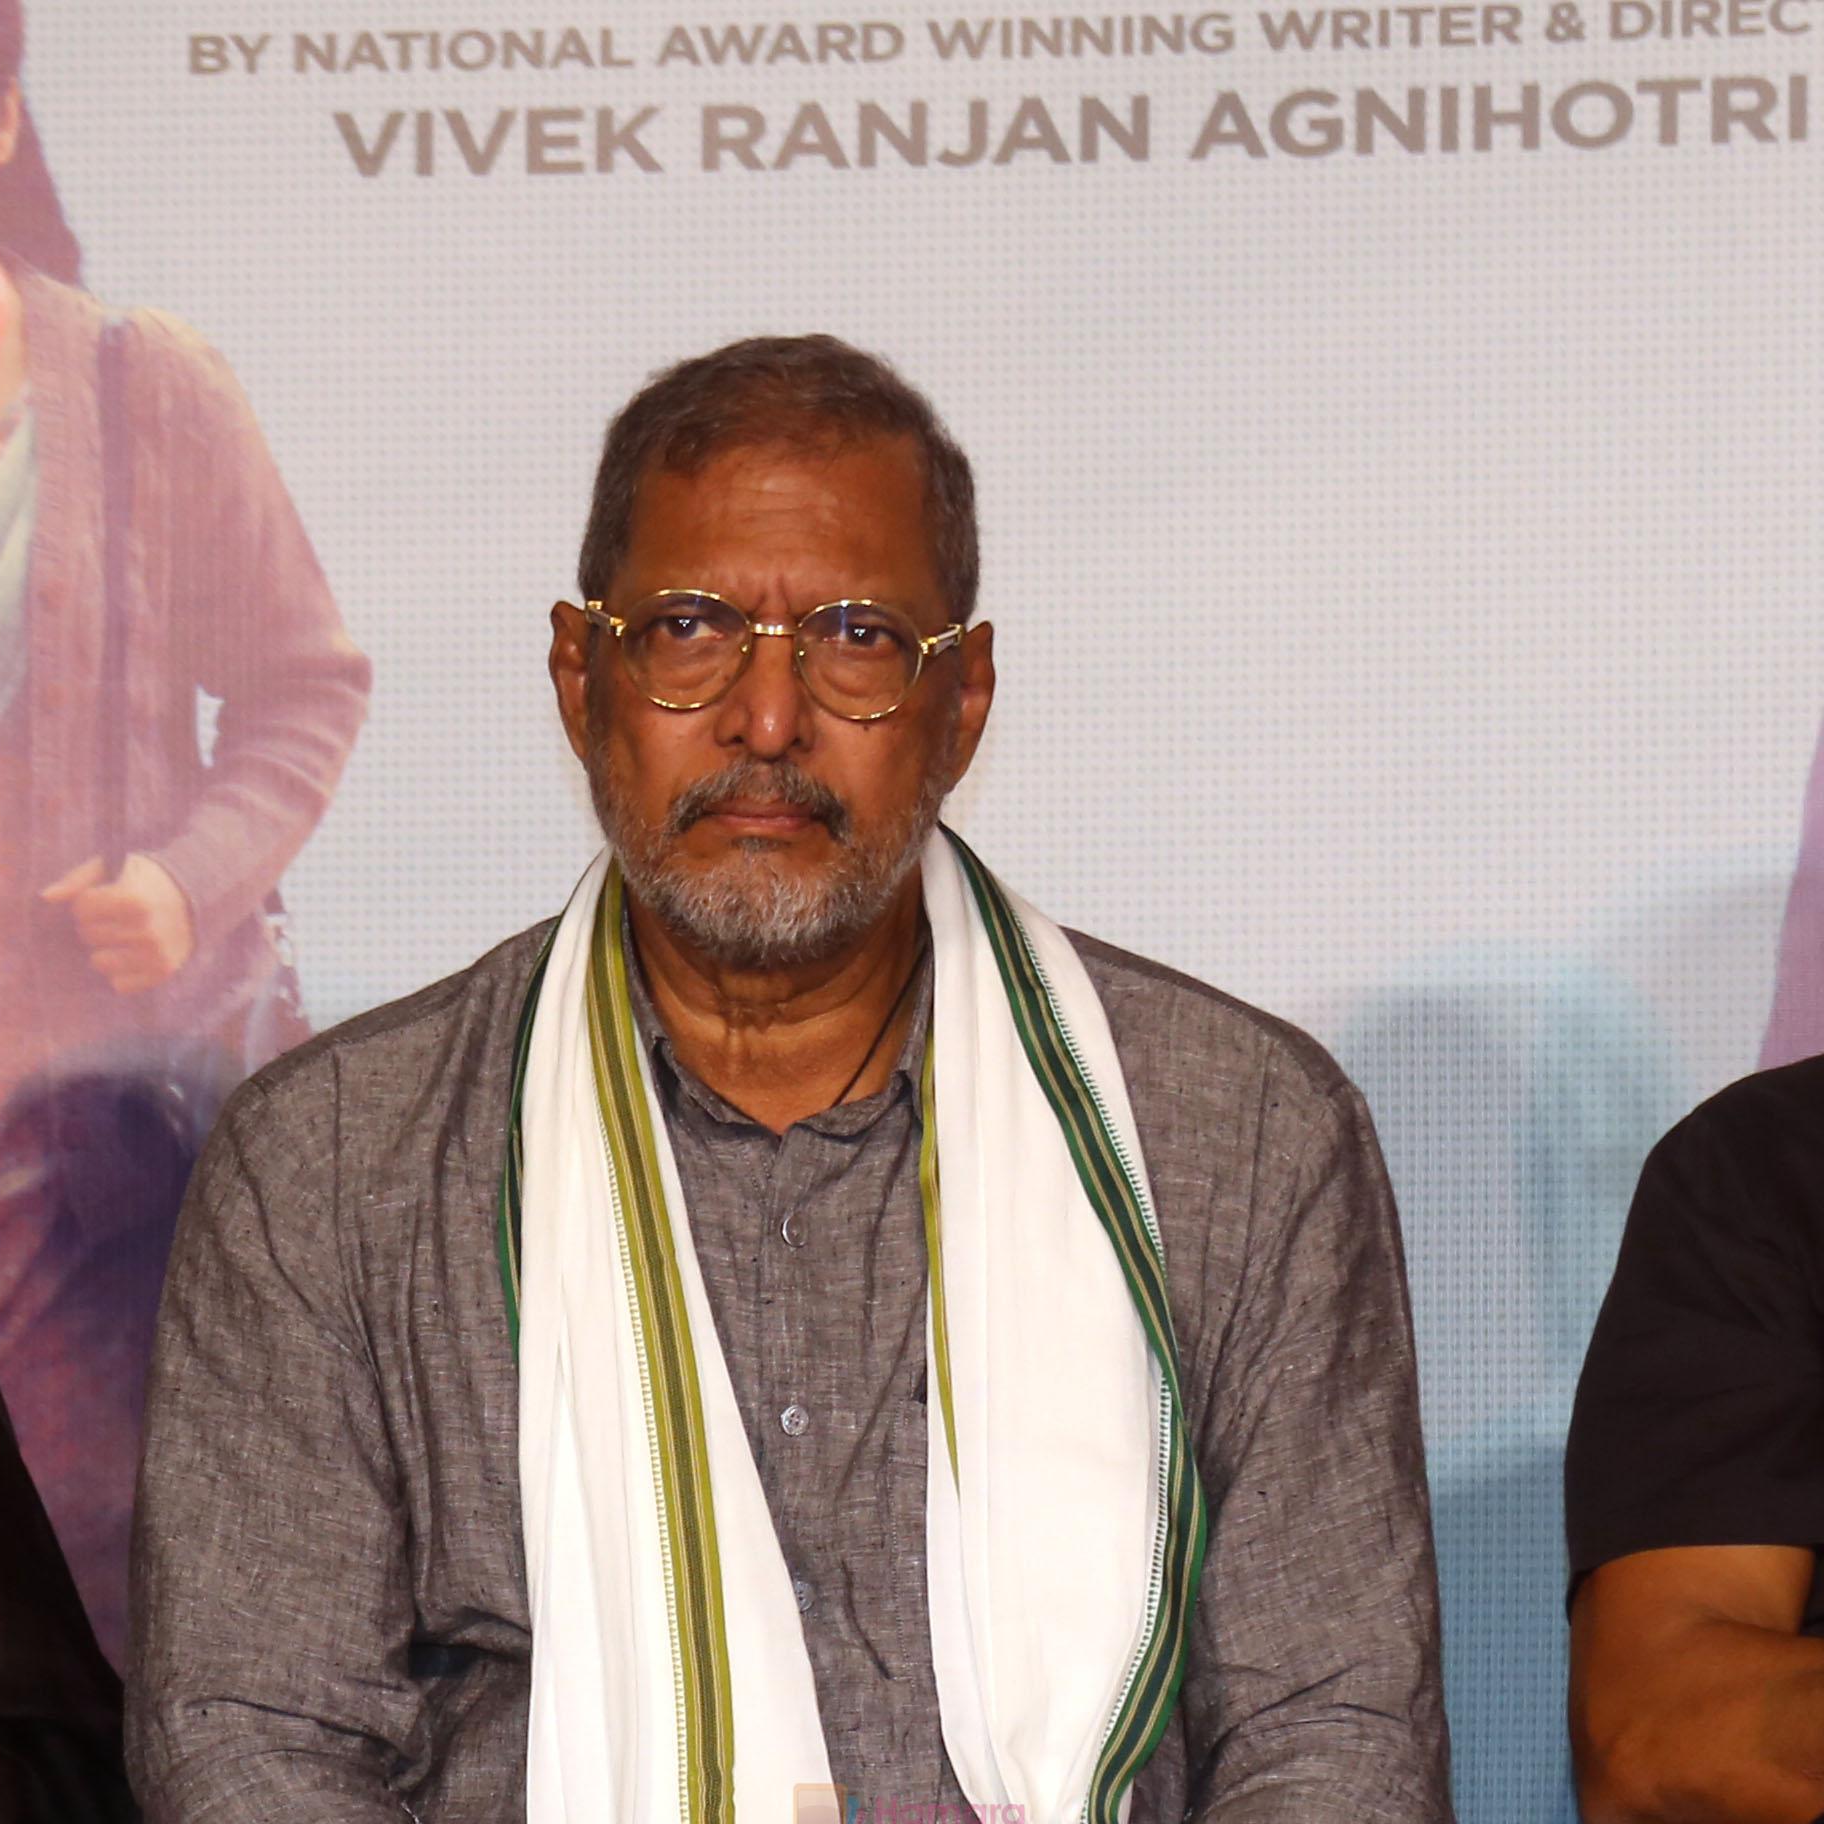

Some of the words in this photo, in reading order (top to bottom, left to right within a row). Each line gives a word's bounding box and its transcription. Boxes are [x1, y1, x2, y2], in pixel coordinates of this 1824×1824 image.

[188, 33, 272, 74] BY
[292, 26, 634, 74] NATIONAL
[656, 21, 907, 66] AWARD
[926, 12, 1236, 61] WINNING
[1258, 4, 1523, 52] WRITER
[1544, 3, 1587, 42] &
[332, 106, 666, 178] VIVEK
[701, 95, 1151, 173] RANJAN
[1188, 74, 1810, 162] AGNIHOTRI
